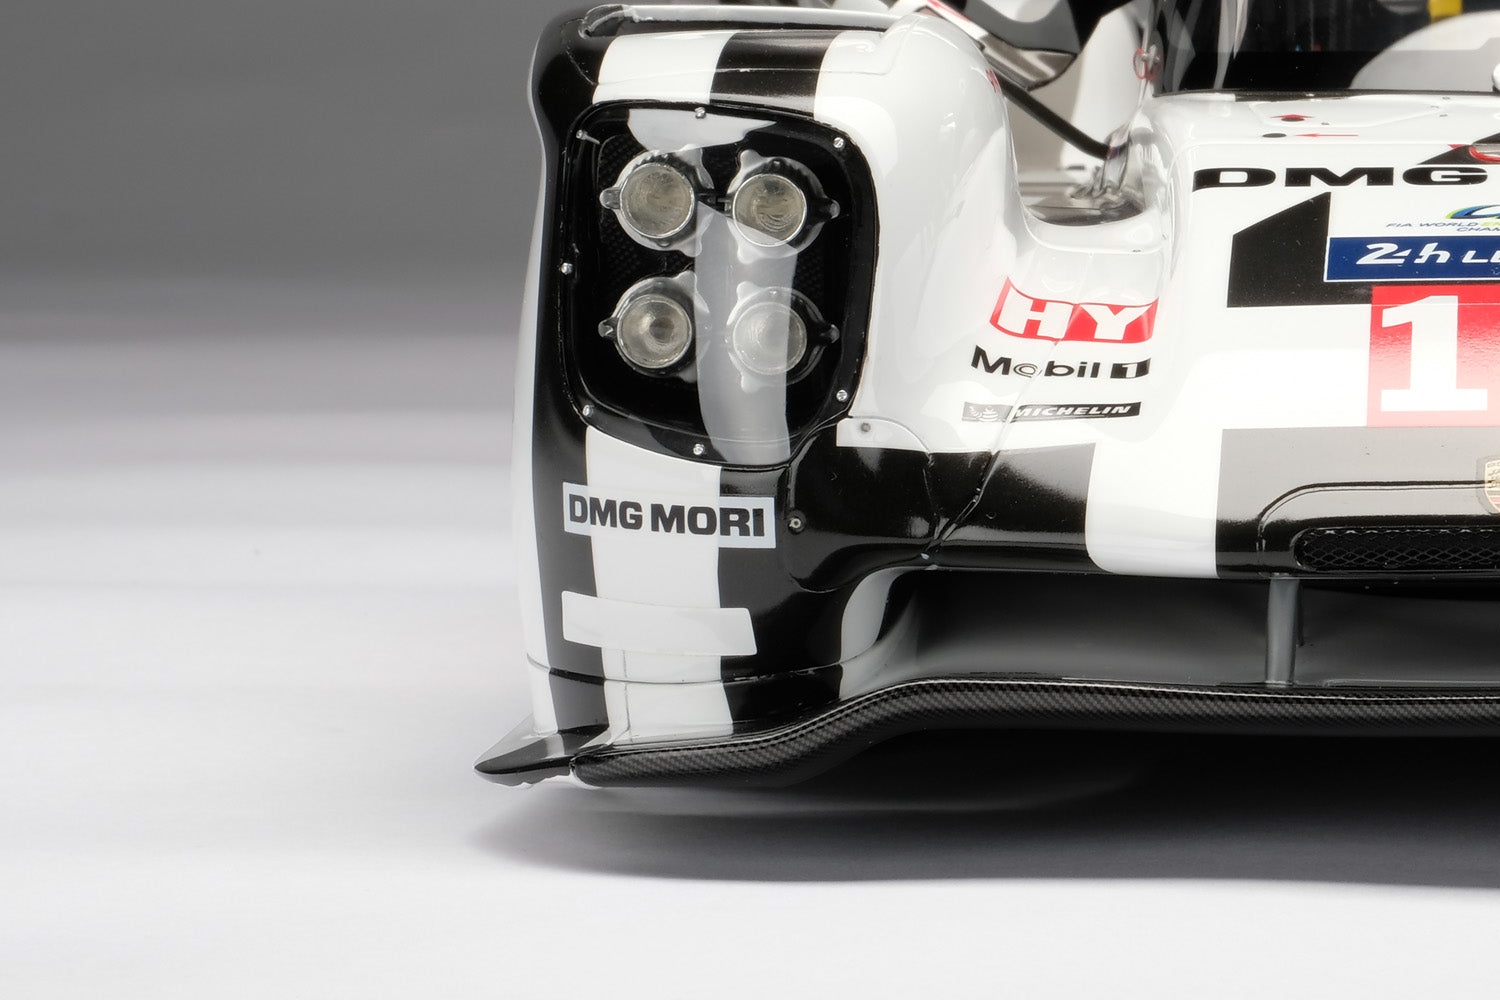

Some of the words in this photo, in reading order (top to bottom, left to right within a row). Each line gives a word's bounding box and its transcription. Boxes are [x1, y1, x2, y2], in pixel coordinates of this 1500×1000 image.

[1192, 166, 1488, 192] DMG
[997, 286, 1153, 341] HY
[971, 345, 1101, 378] Mobil
[1014, 405, 1132, 418] MICHELIN
[569, 493, 643, 531] DMG
[650, 503, 765, 537] MORI
